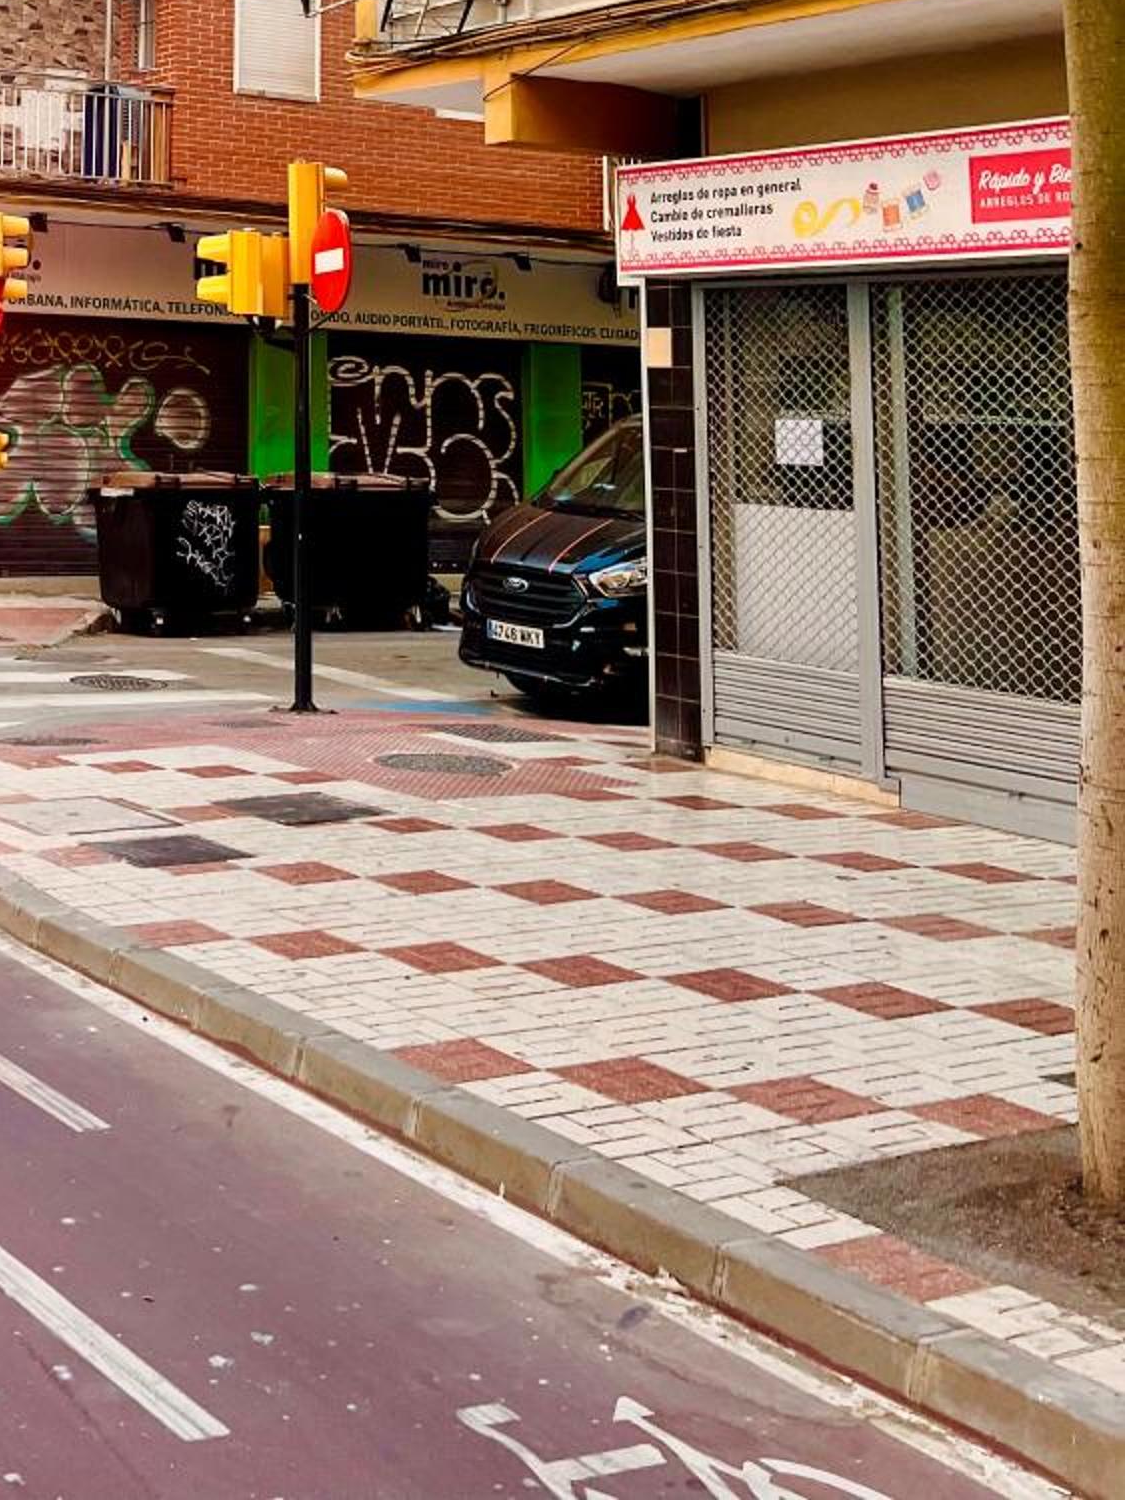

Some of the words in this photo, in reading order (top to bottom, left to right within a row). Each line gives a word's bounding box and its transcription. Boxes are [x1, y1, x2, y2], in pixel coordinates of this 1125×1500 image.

[650, 189, 694, 205] Arreglos
[696, 187, 709, 200] de
[712, 185, 737, 201] ropa
[740, 184, 754, 197] en
[756, 178, 802, 198] general
[1032, 171, 1045, 195] y
[1055, 191, 1071, 203] RO
[650, 208, 688, 223] Cambio
[691, 207, 704, 220] de
[706, 203, 773, 220] cremalleras
[650, 227, 694, 242] Vestidos
[696, 227, 709, 240] de
[712, 226, 742, 239] fiesta
[70, 295, 164, 314] INFORMÁTICA,
[354, 312, 391, 326] AUDIO
